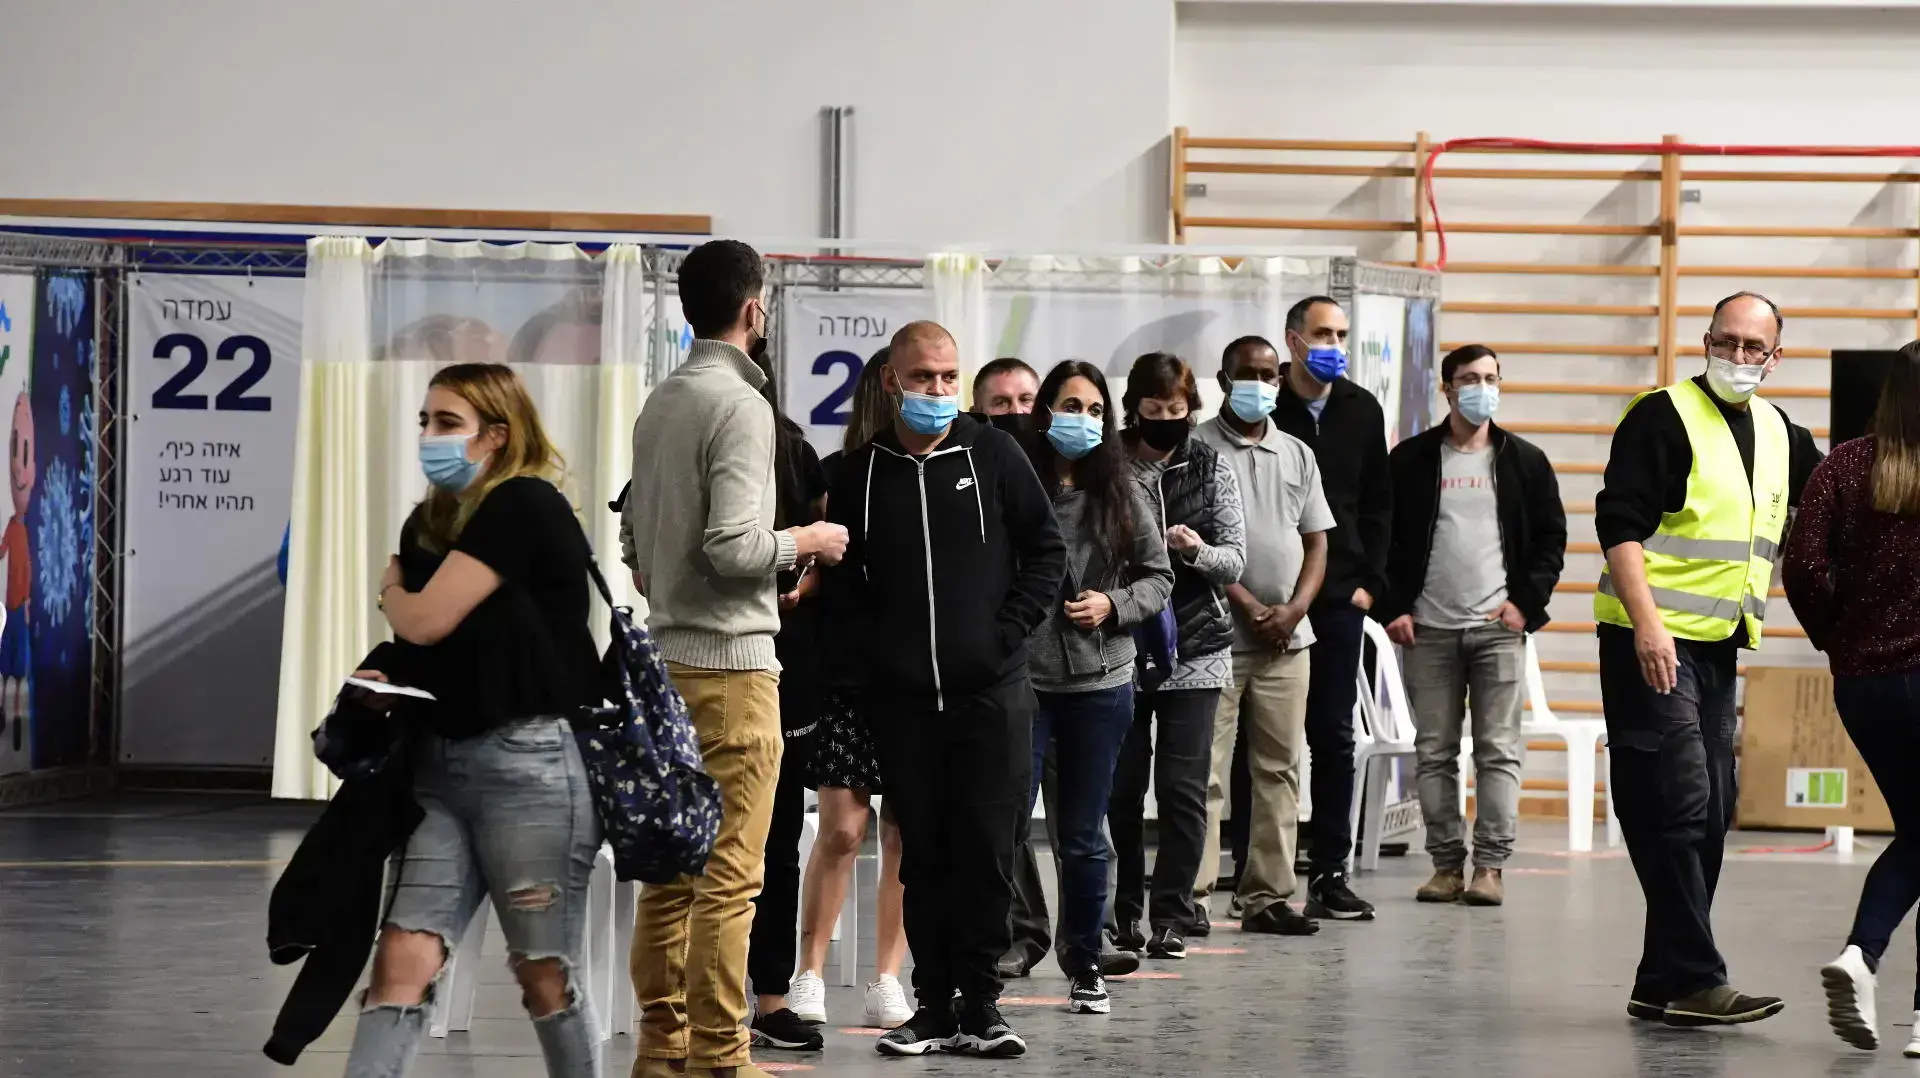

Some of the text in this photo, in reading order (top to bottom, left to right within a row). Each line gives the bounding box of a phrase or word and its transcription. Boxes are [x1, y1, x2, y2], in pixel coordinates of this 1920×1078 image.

[162, 298, 232, 321] עמדה
[818, 315, 887, 338] עמדה
[151, 332, 272, 412] 22
[159, 440, 241, 460] איזה כיף,
[159, 467, 231, 484] עוד רגע
[158, 490, 254, 511] תהיו אחרי!
